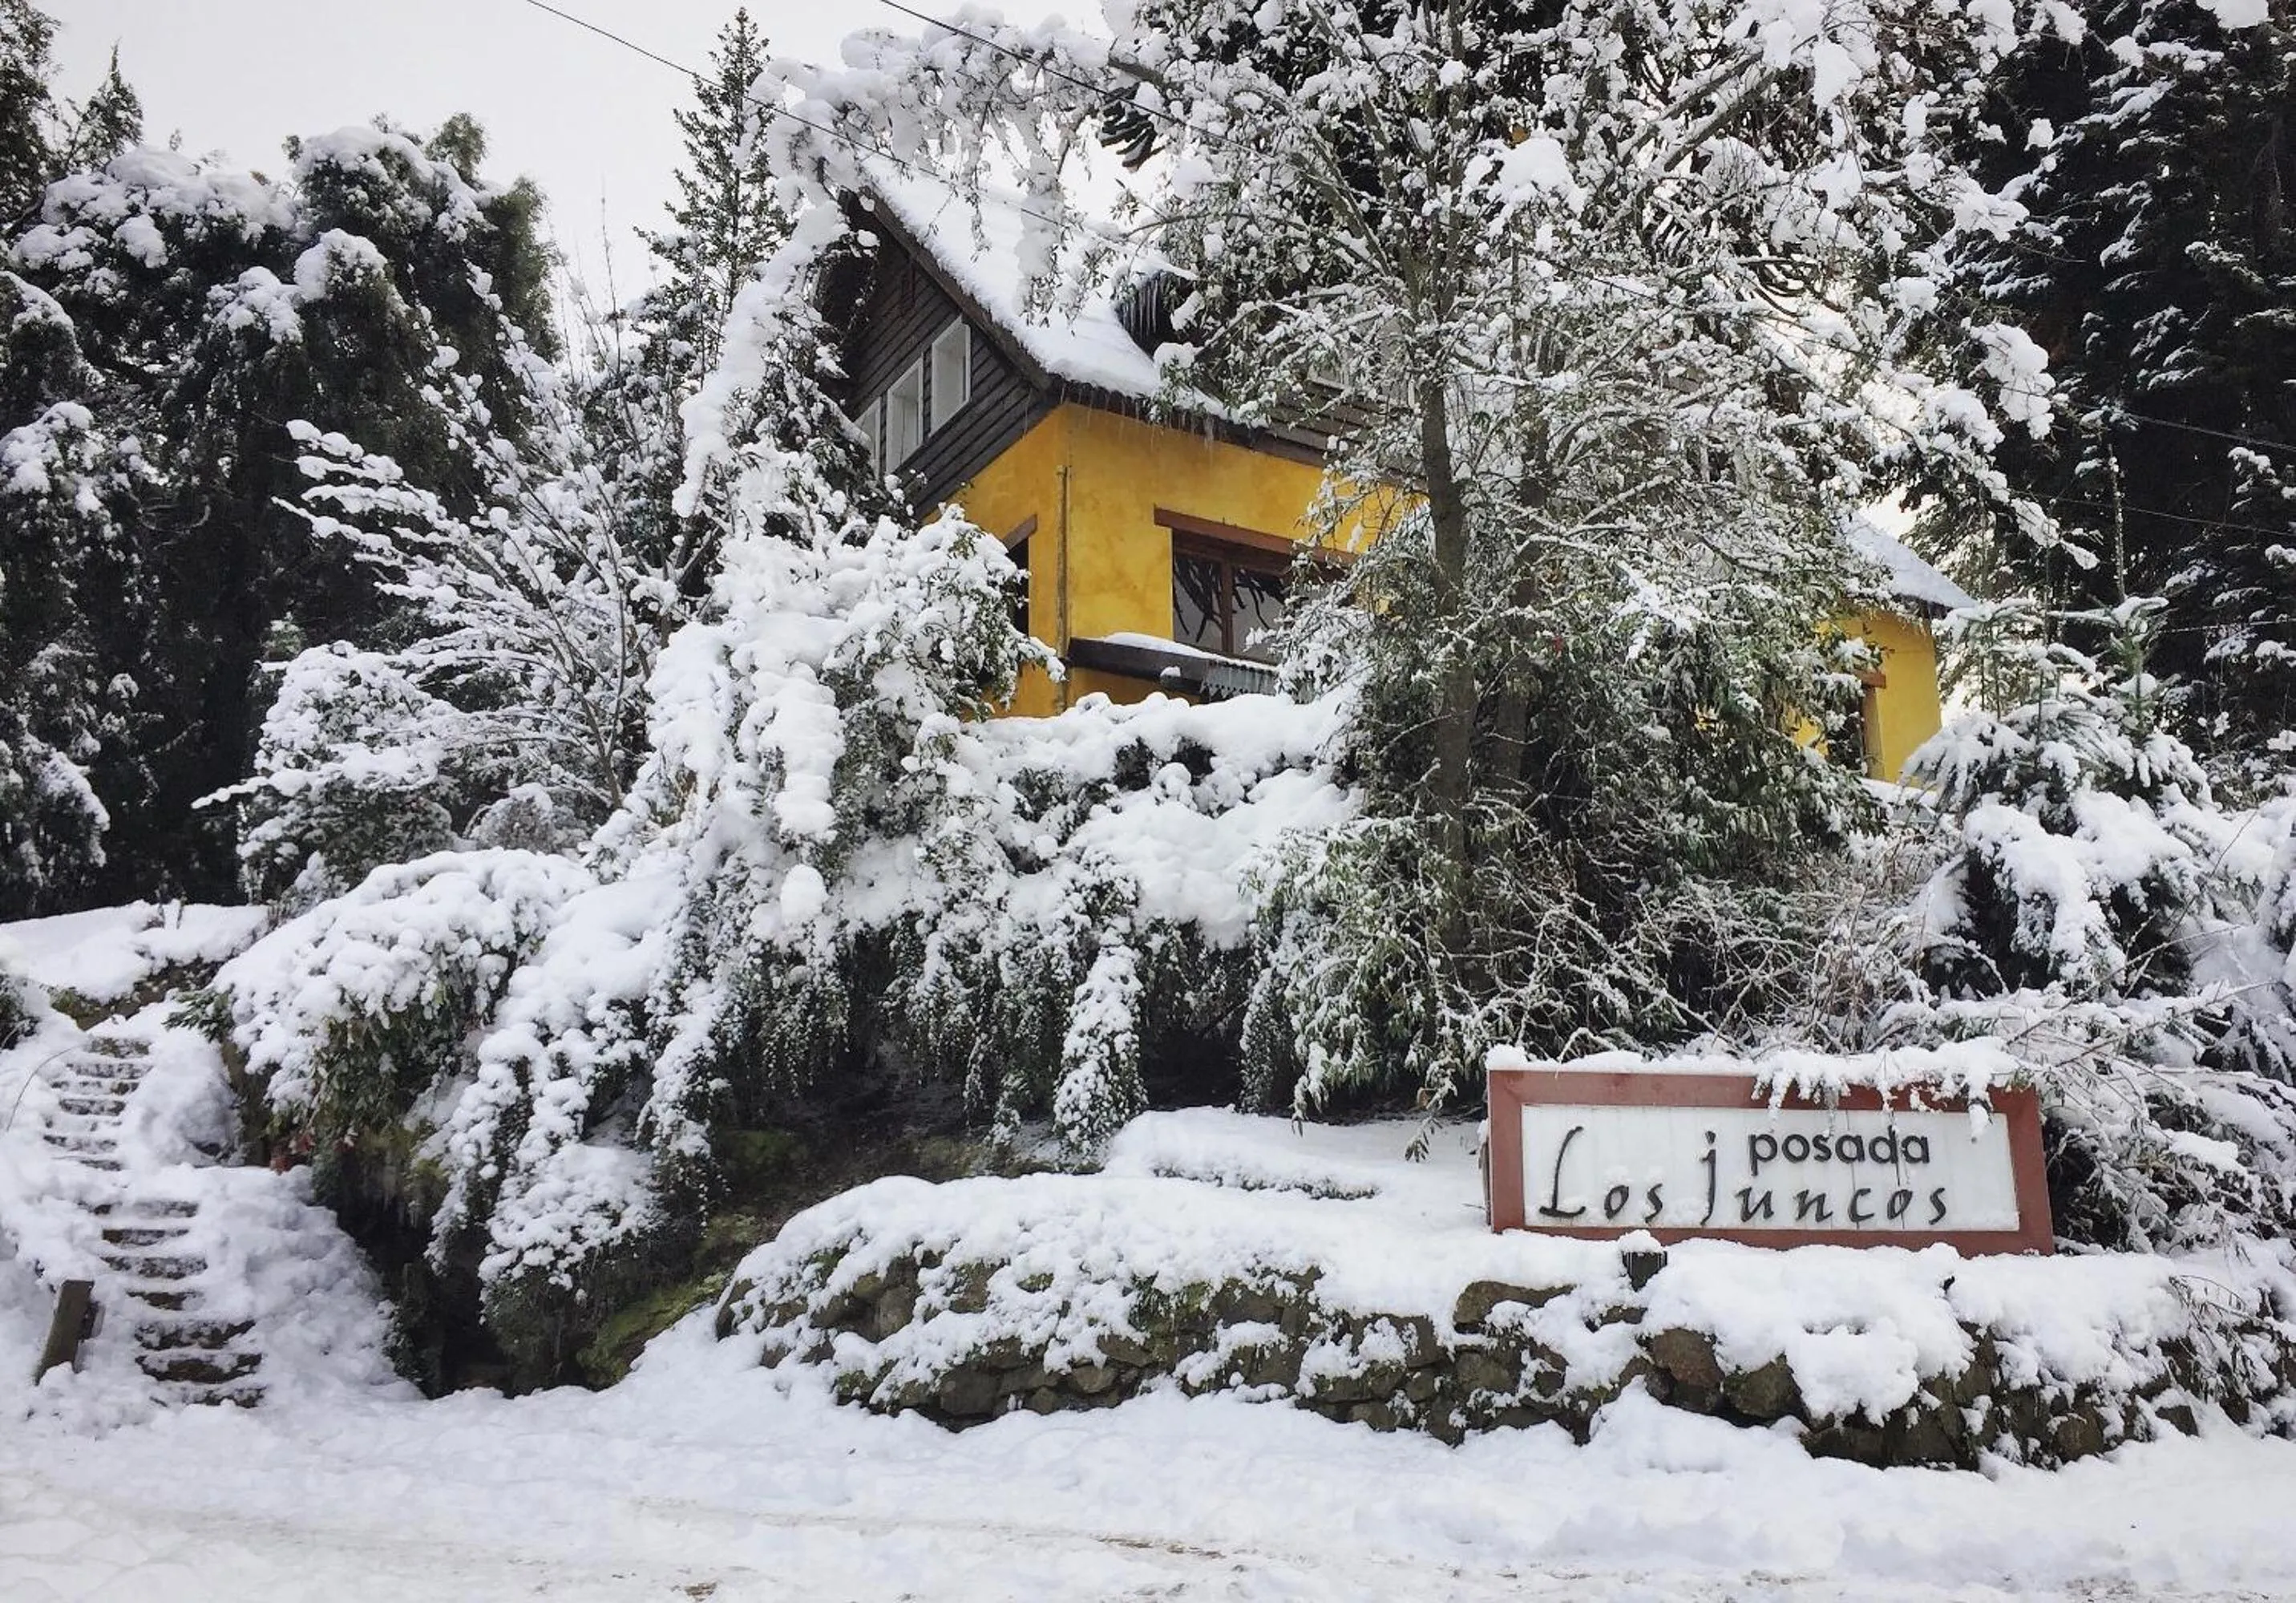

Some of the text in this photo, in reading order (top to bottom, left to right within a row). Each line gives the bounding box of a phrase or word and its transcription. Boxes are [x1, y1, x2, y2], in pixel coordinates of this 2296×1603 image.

[1538, 1126, 1947, 1226] Los juncos
[1748, 1126, 1930, 1176] posada
